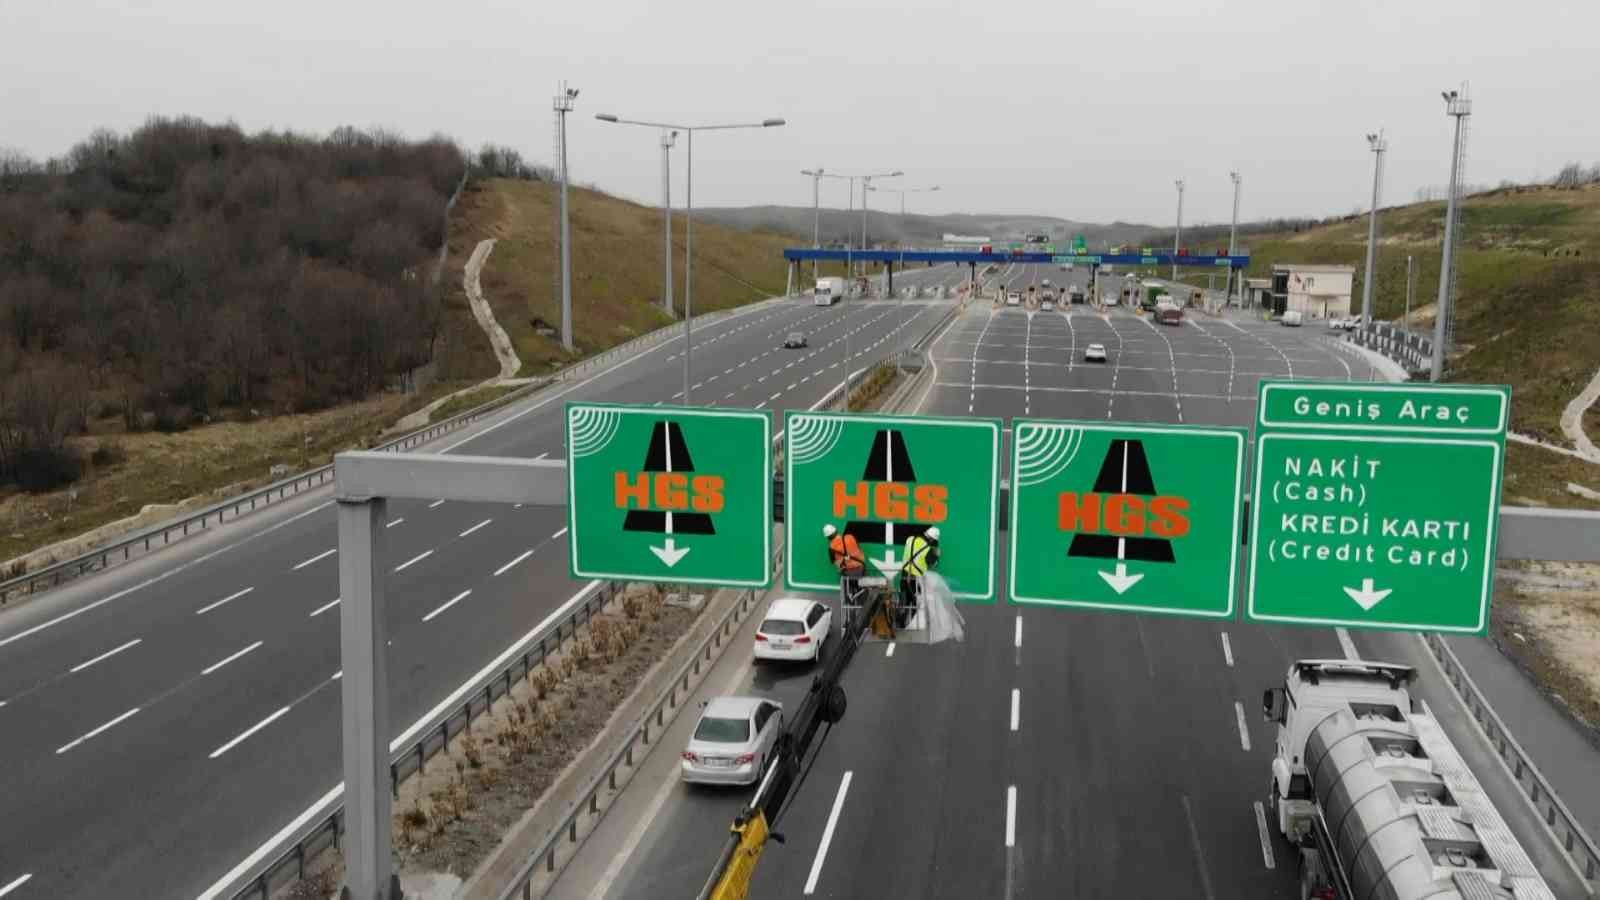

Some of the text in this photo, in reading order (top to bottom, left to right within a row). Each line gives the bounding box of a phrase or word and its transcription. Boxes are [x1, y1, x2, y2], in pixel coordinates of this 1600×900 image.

[1294, 396, 1470, 422] Geniş Araç
[1285, 455, 1381, 479] NAKİT
[615, 472, 724, 512] HGS
[832, 481, 948, 522] HGS
[1273, 481, 1366, 506] (Cash)
[1059, 491, 1190, 537] HGS
[1281, 513, 1470, 541] KREDİ KARTI
[1387, 545, 1469, 571] Card)
